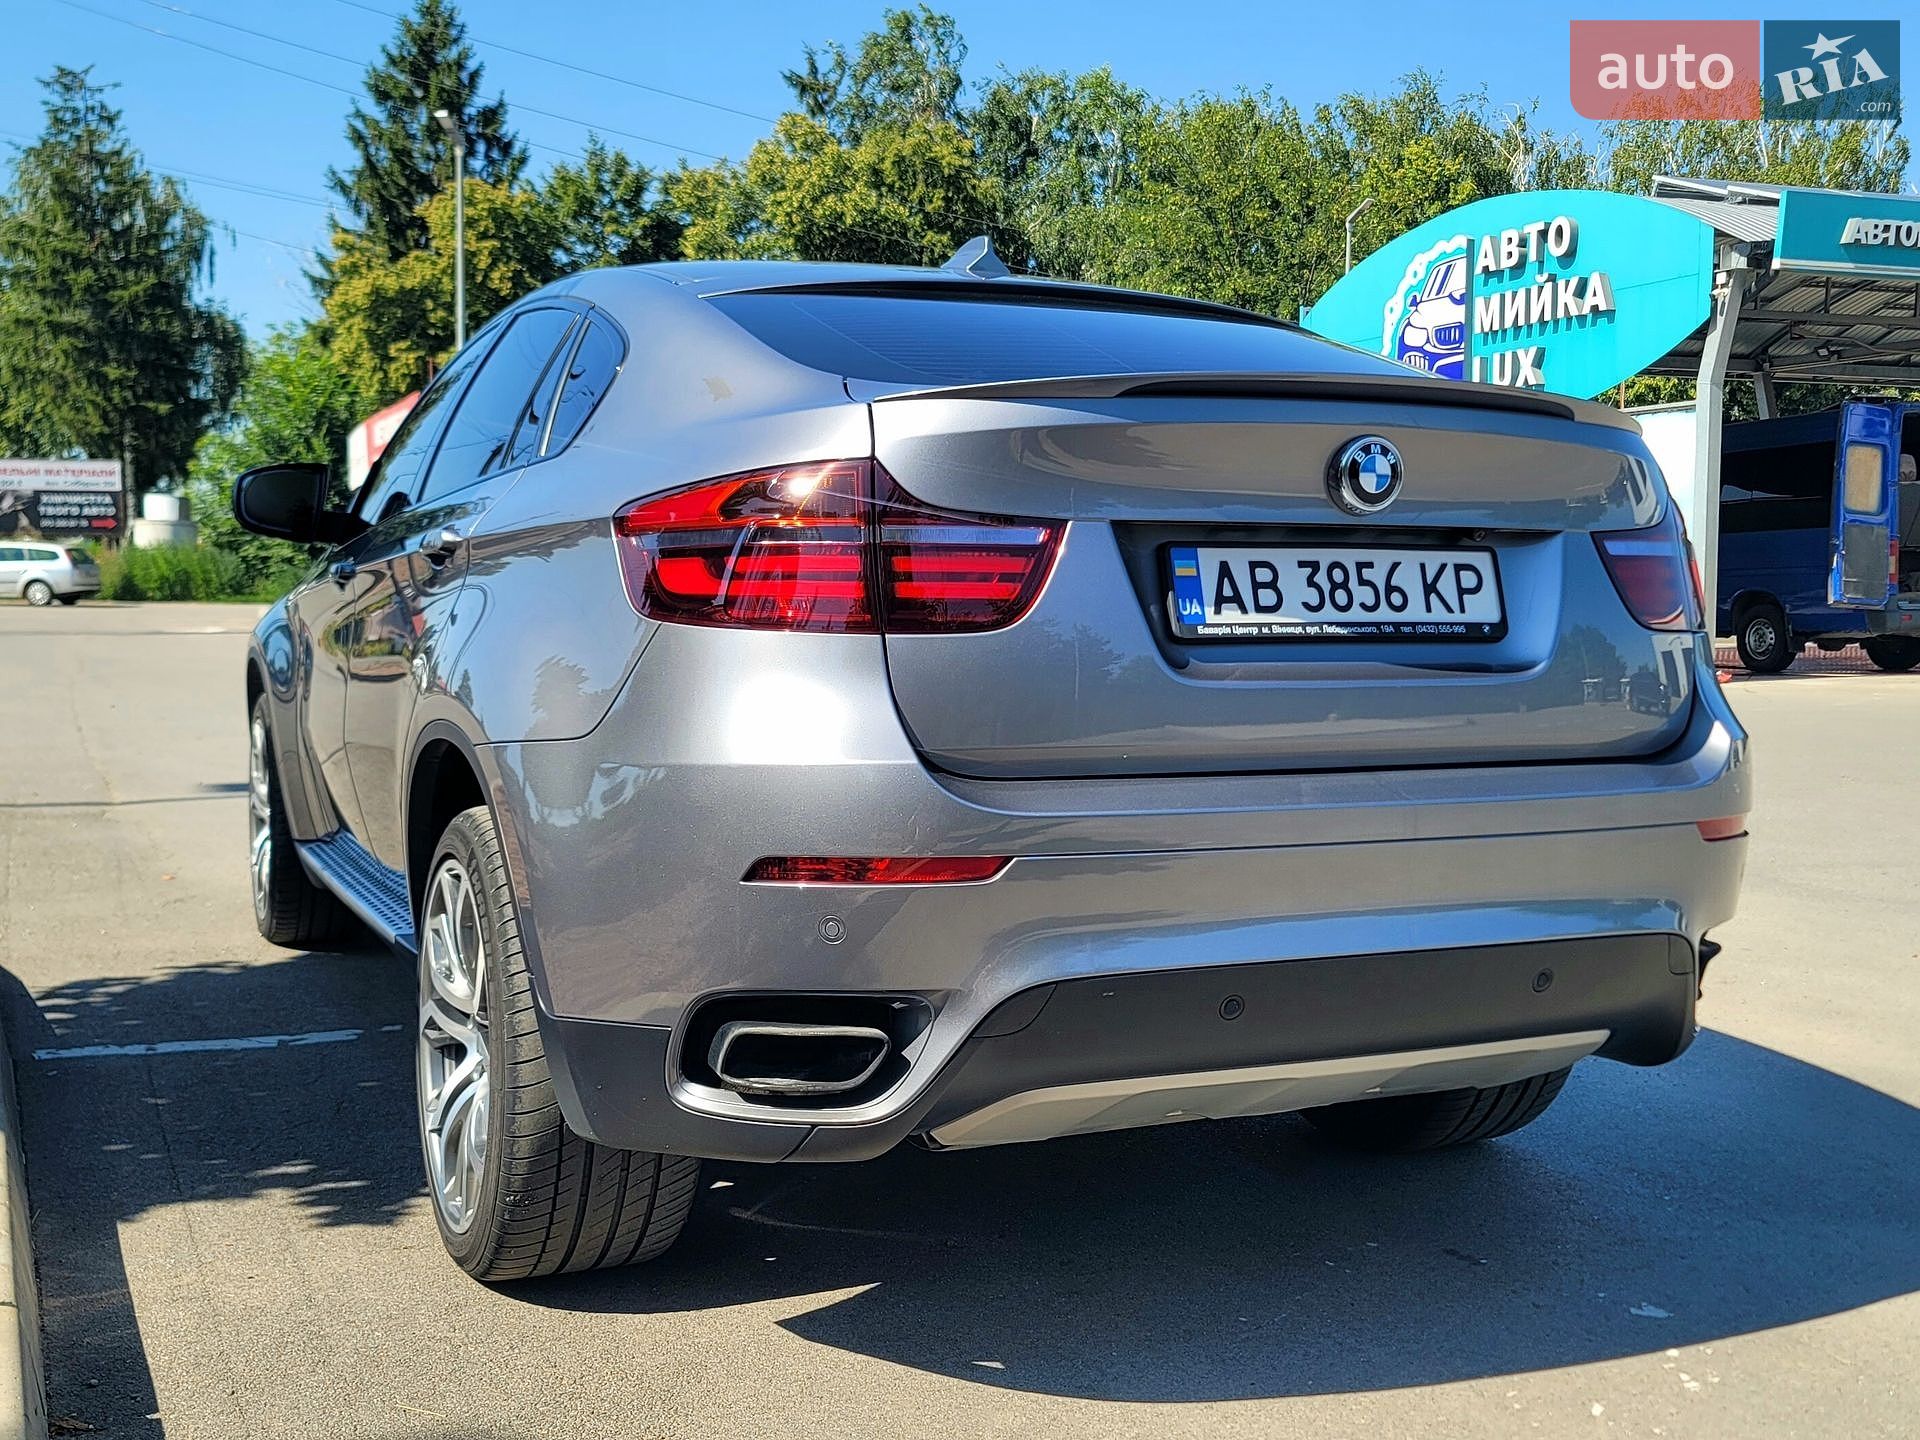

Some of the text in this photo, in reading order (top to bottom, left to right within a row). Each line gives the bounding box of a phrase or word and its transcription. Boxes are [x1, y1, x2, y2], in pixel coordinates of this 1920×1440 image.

[1475, 215, 1578, 275] АВТО
[1840, 216, 1920, 248] АВТО
[1474, 271, 1615, 334] МИЙКА
[1354, 444, 1396, 465] BMW
[1178, 598, 1203, 616] UA
[1213, 560, 1484, 615] AB 3856 KP
